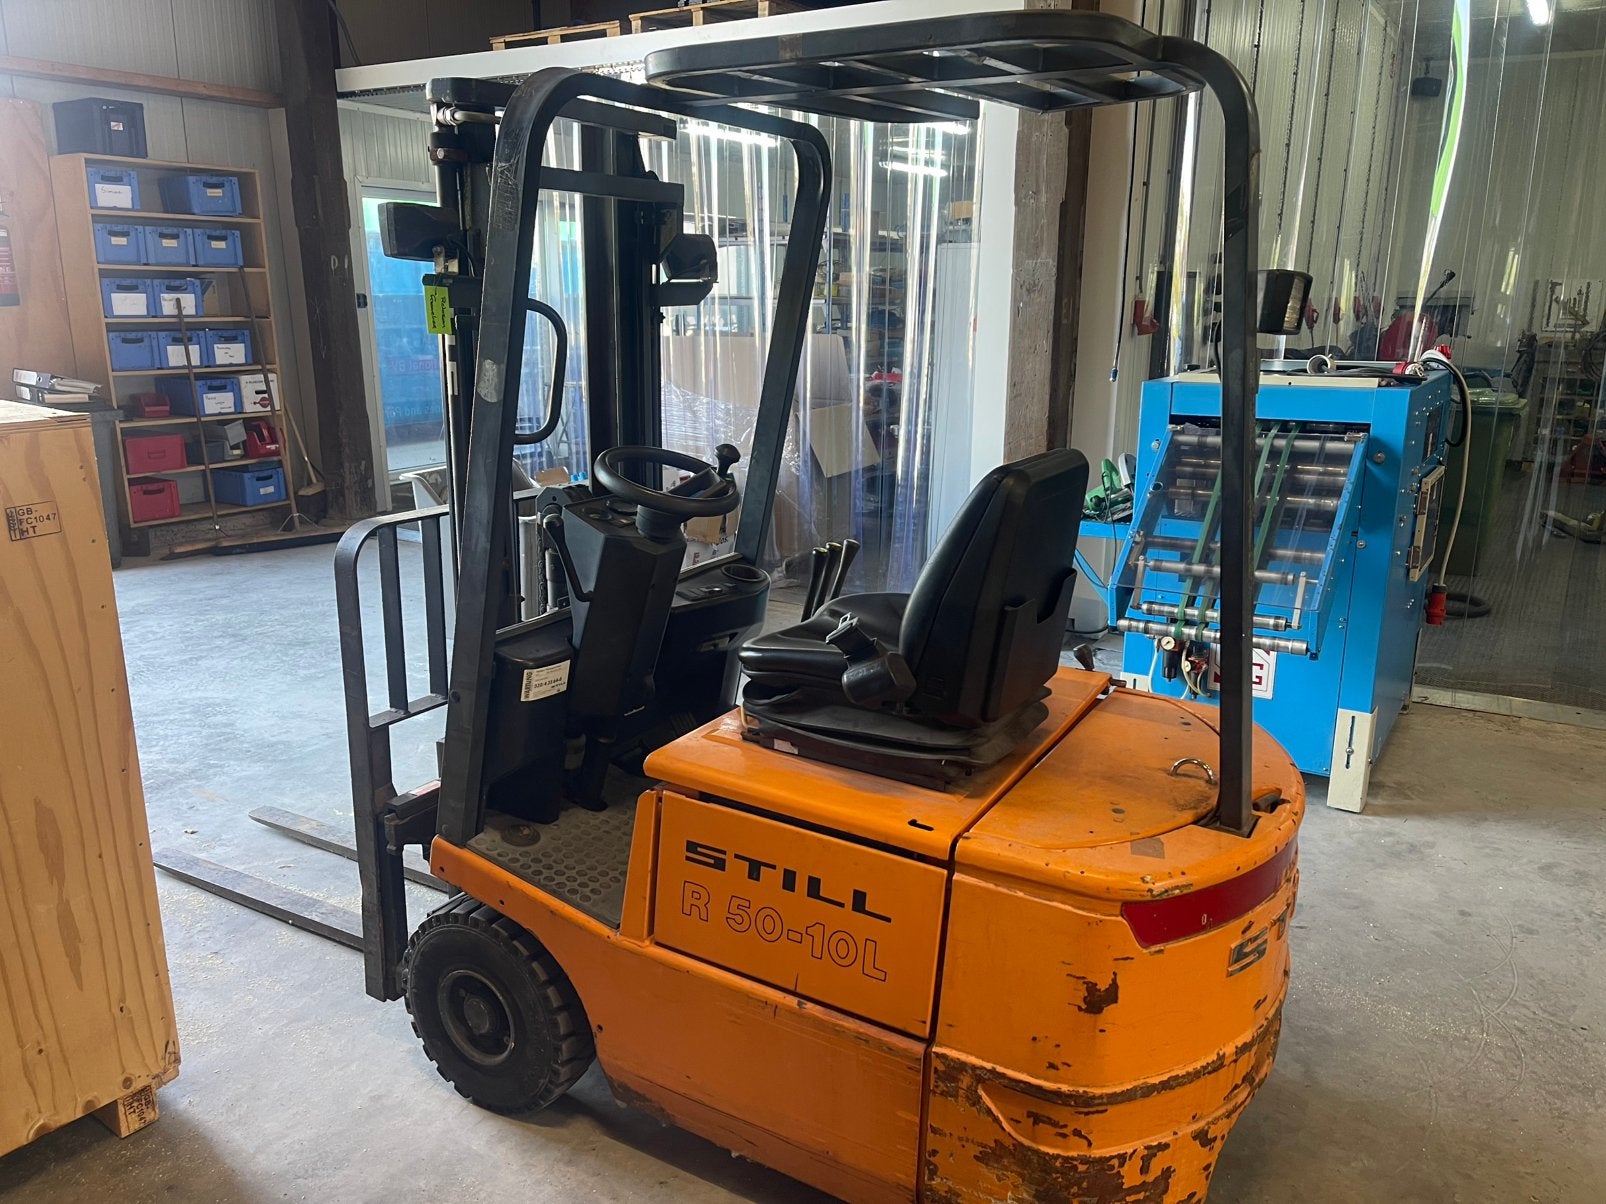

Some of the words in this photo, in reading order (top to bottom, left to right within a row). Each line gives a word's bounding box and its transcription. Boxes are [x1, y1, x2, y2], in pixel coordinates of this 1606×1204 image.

[19, 513, 57, 526] FC1047
[20, 525, 38, 536] HT
[685, 840, 892, 923] STILL
[682, 880, 710, 922] R
[726, 895, 887, 982] 50-10L
